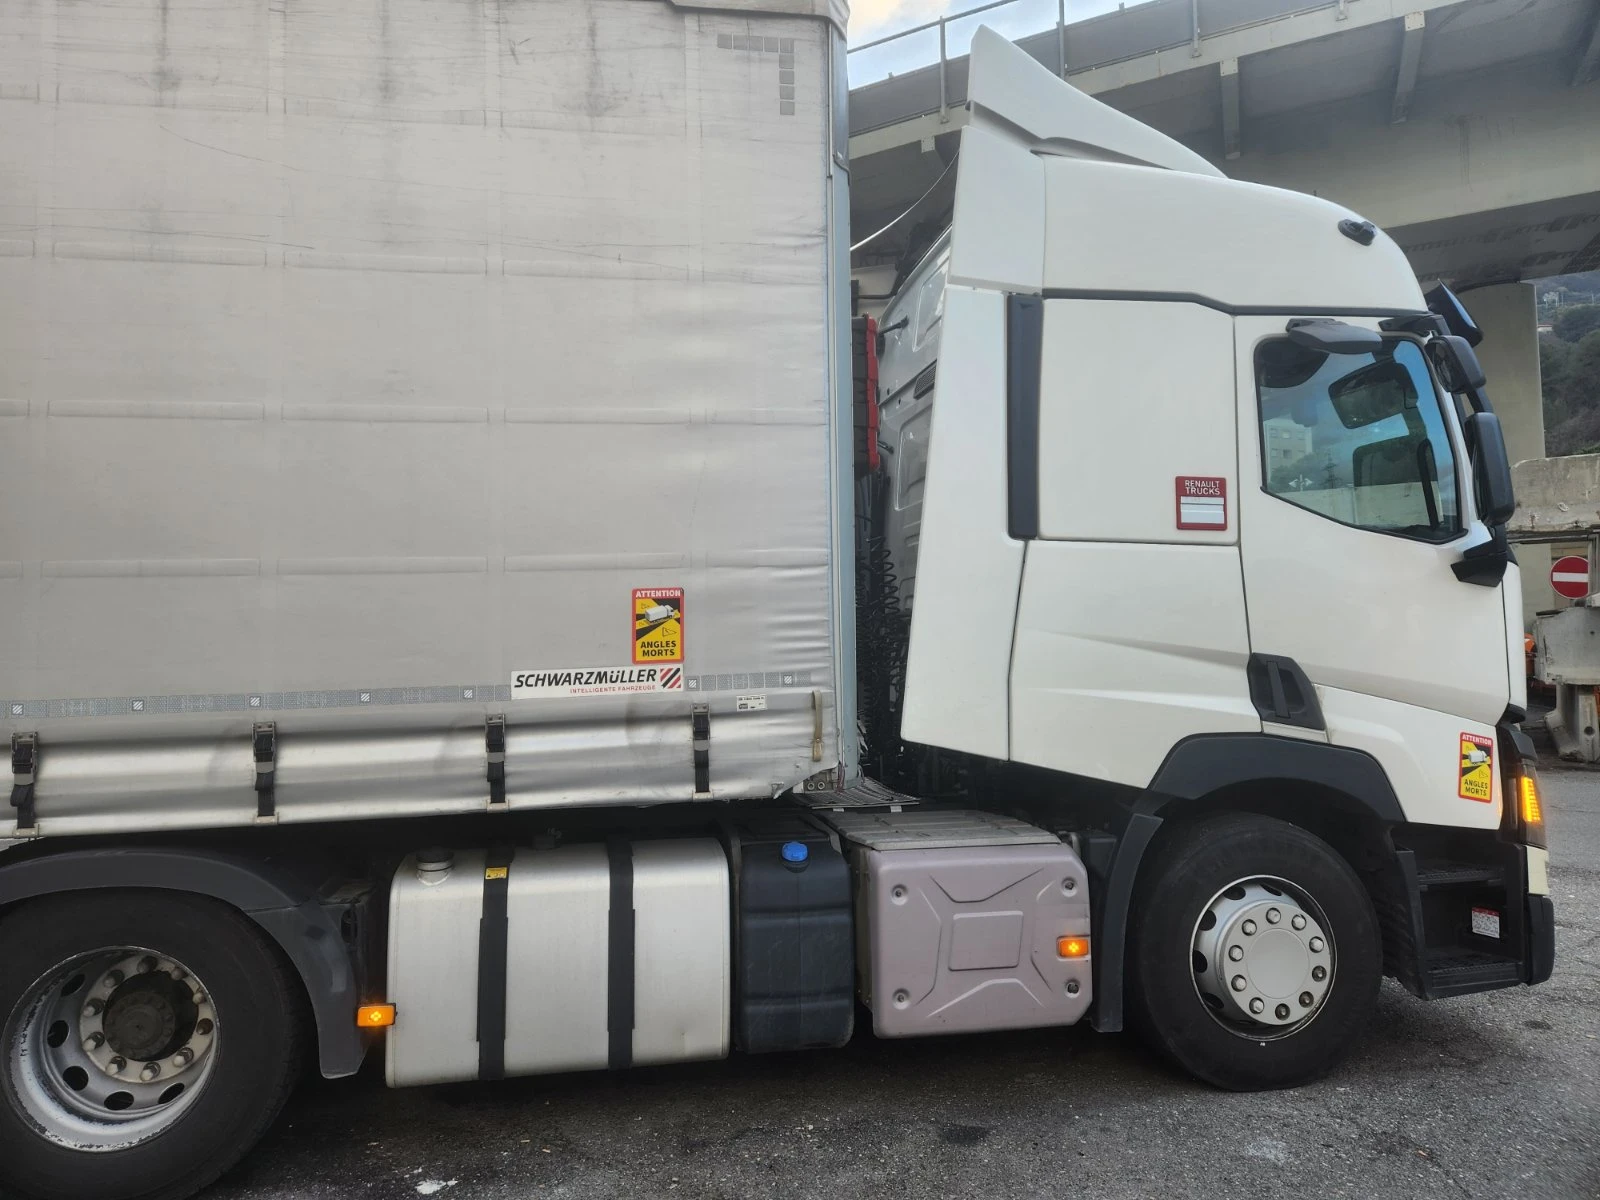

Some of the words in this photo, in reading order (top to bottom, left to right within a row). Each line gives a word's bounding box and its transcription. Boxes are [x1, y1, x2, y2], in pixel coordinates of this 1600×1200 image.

[1185, 487, 1221, 495] TRUCKS
[635, 590, 681, 598] ATTENTION
[640, 640, 677, 649] ANGLES
[642, 648, 675, 657] MORTS
[514, 669, 657, 688] SCHWARZMÜLLER
[569, 686, 616, 694] INTELLIGENTE
[617, 684, 656, 692] FAHRZEUGE
[1462, 734, 1492, 745] ATTENTION
[1464, 779, 1488, 789] ANGLES
[1465, 787, 1487, 796] MORTS
